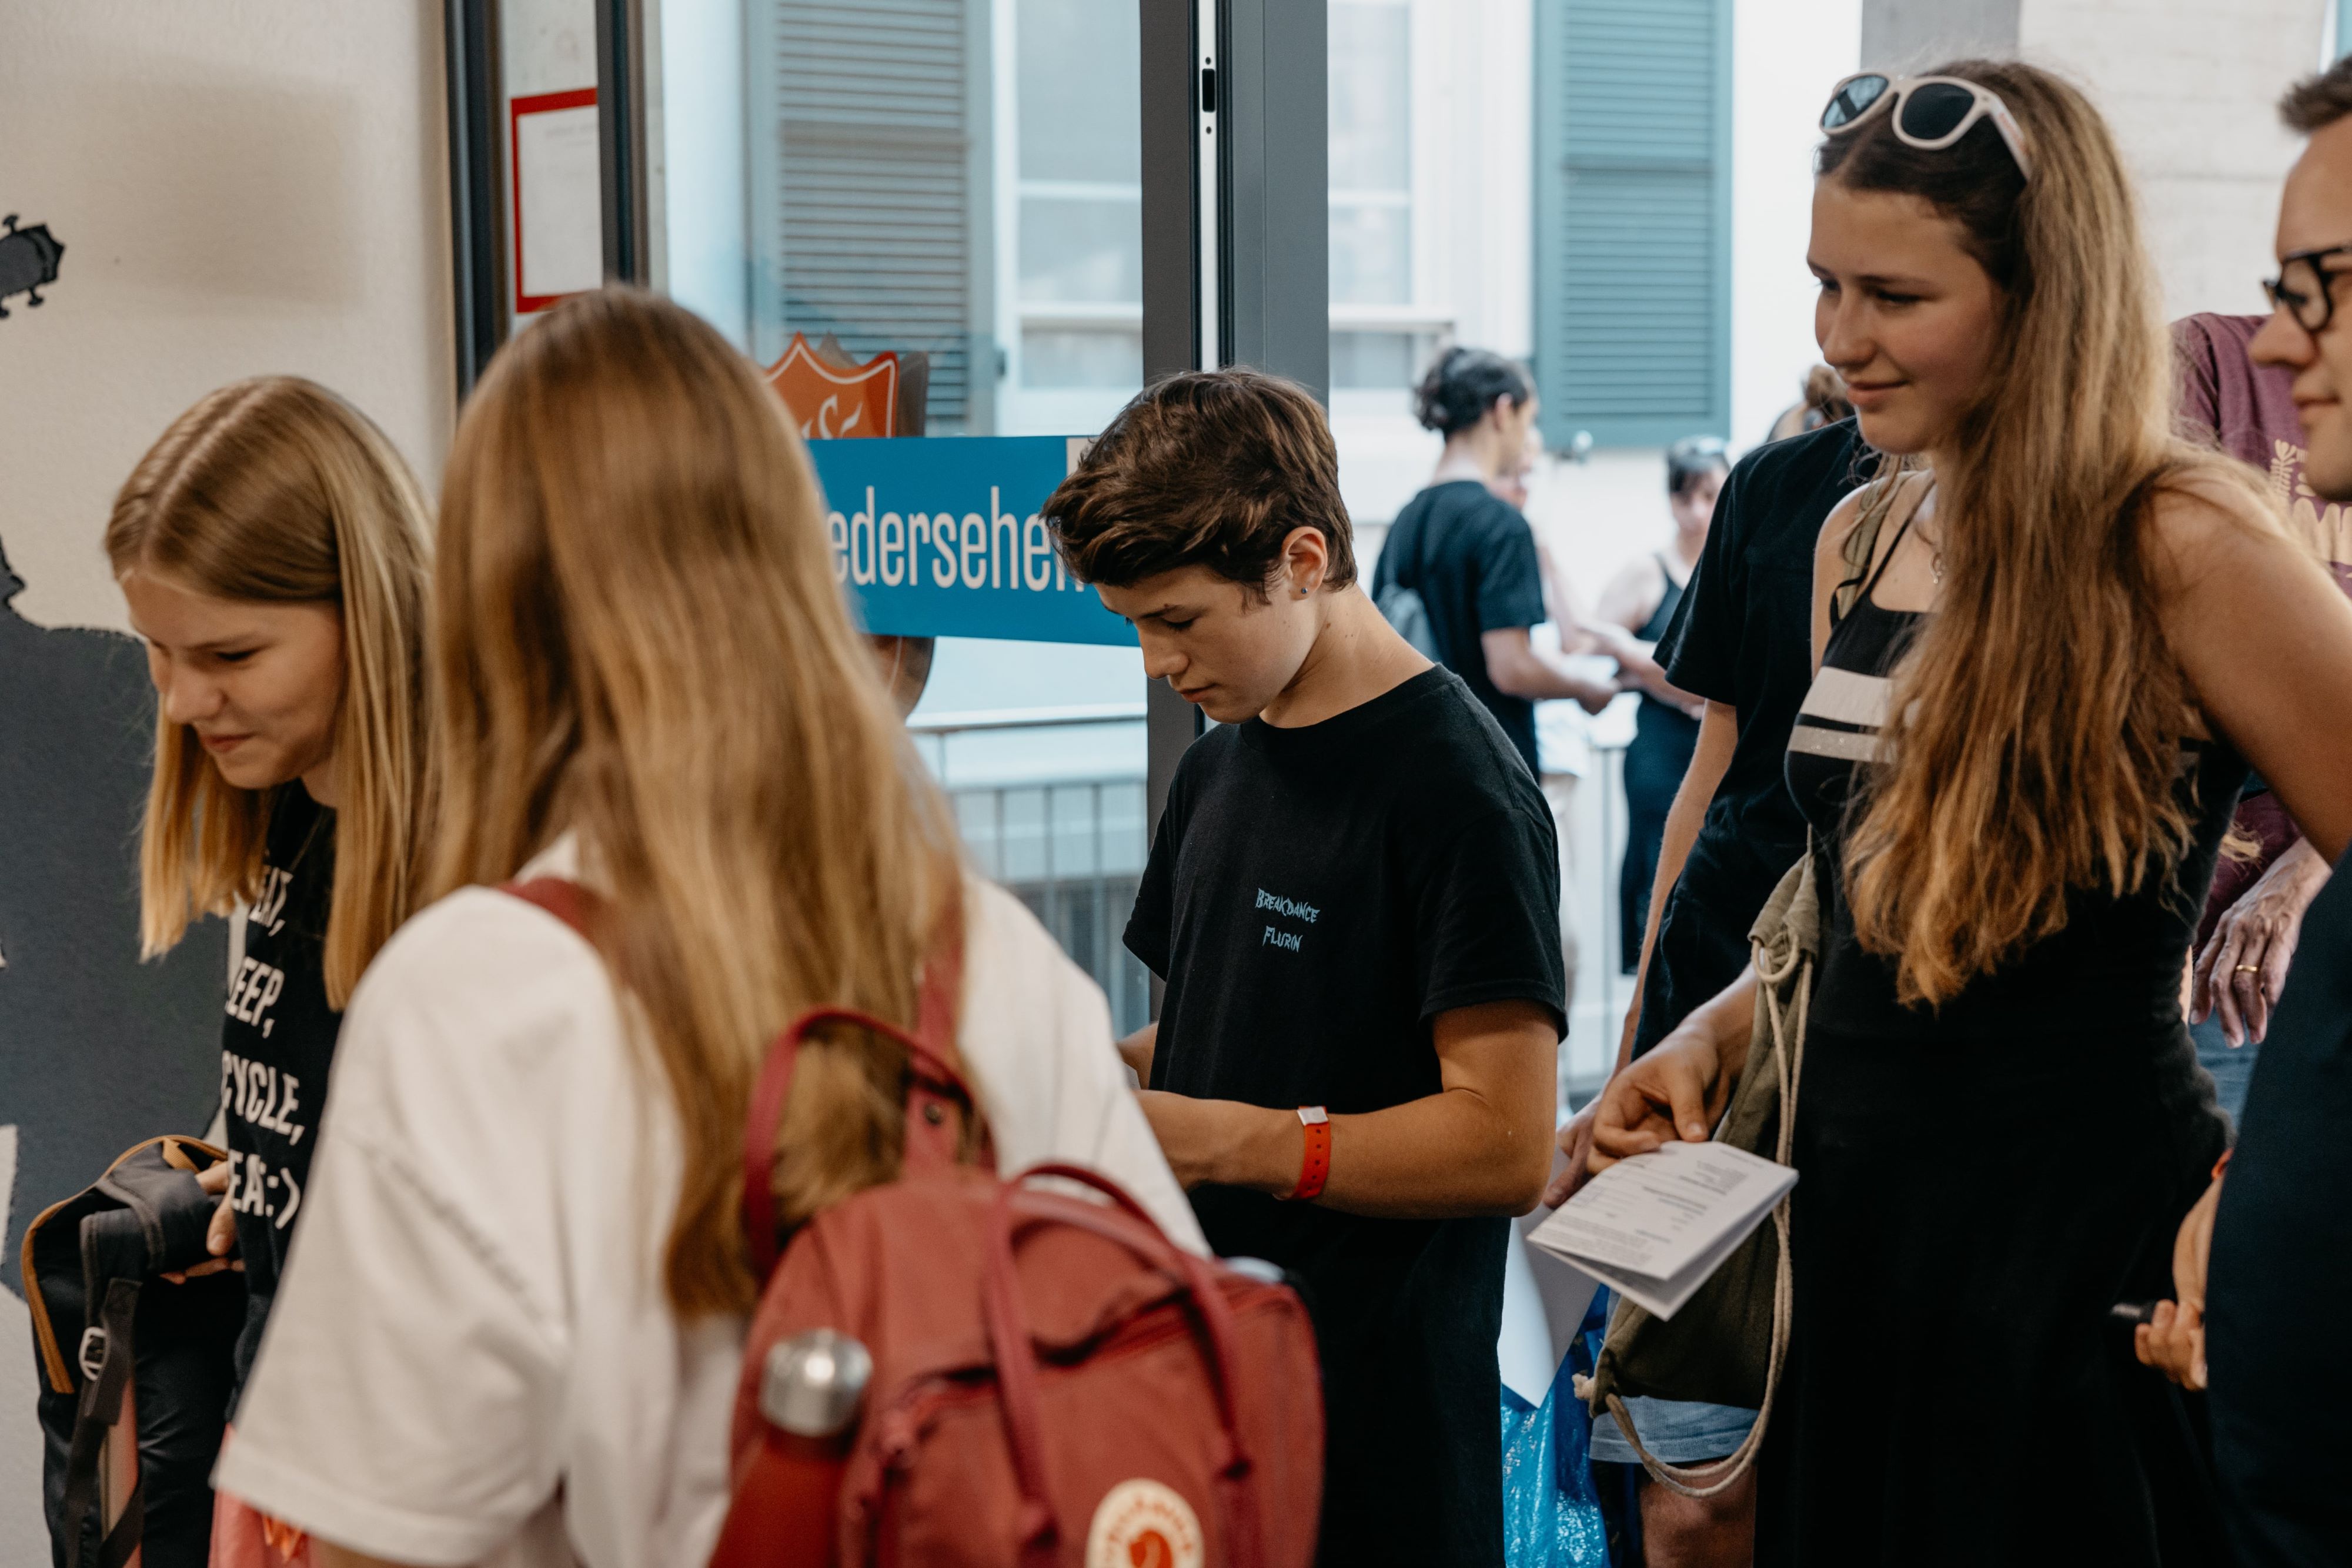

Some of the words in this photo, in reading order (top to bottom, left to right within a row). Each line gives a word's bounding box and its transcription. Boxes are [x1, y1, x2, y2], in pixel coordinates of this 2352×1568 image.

[825, 485, 1085, 593] edersehe
[1255, 888, 1321, 924] BREAKDANCE
[1262, 925, 1304, 953] FLURIN
[225, 956, 285, 1038] EEP,
